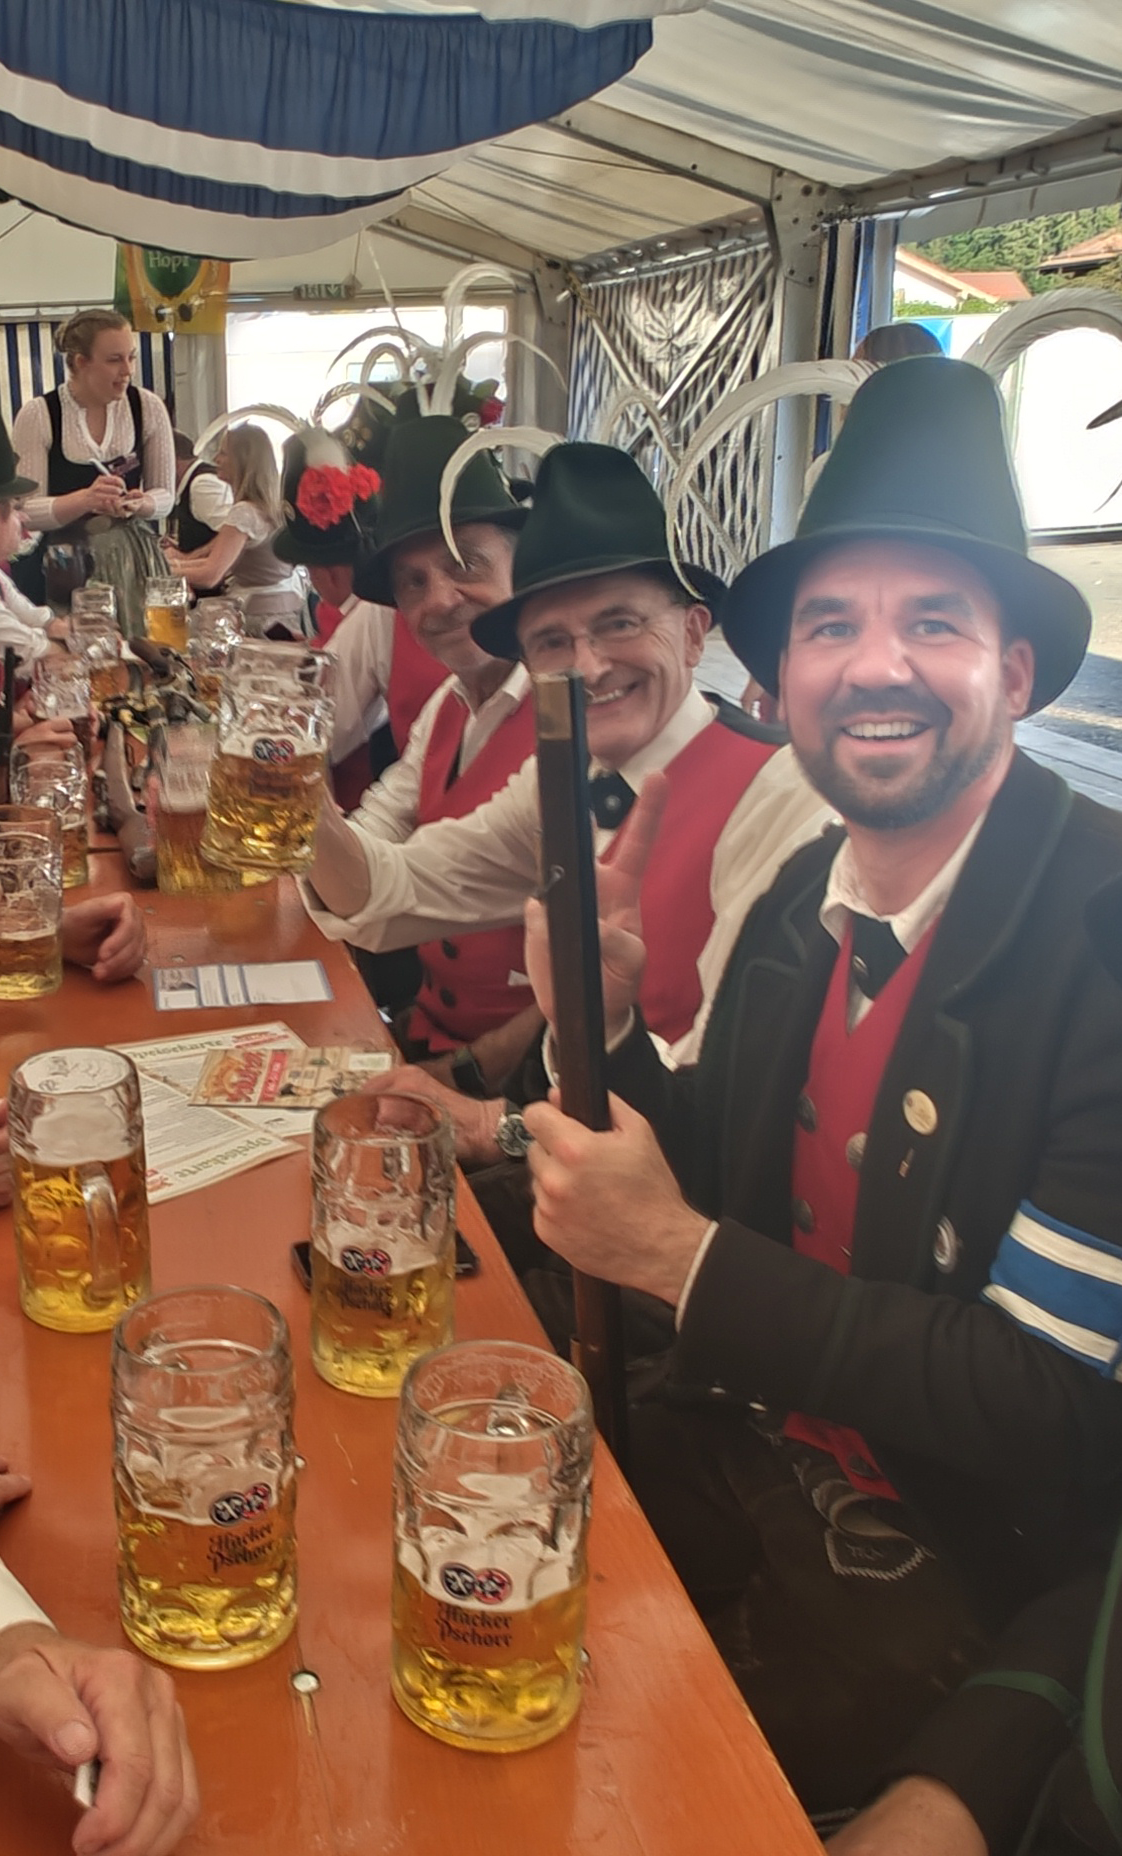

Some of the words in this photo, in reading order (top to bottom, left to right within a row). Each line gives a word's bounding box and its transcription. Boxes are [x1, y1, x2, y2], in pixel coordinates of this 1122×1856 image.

[208, 1521, 273, 1556] Hacker
[437, 1601, 513, 1629] Hacker
[434, 1619, 513, 1648] Pschorr
